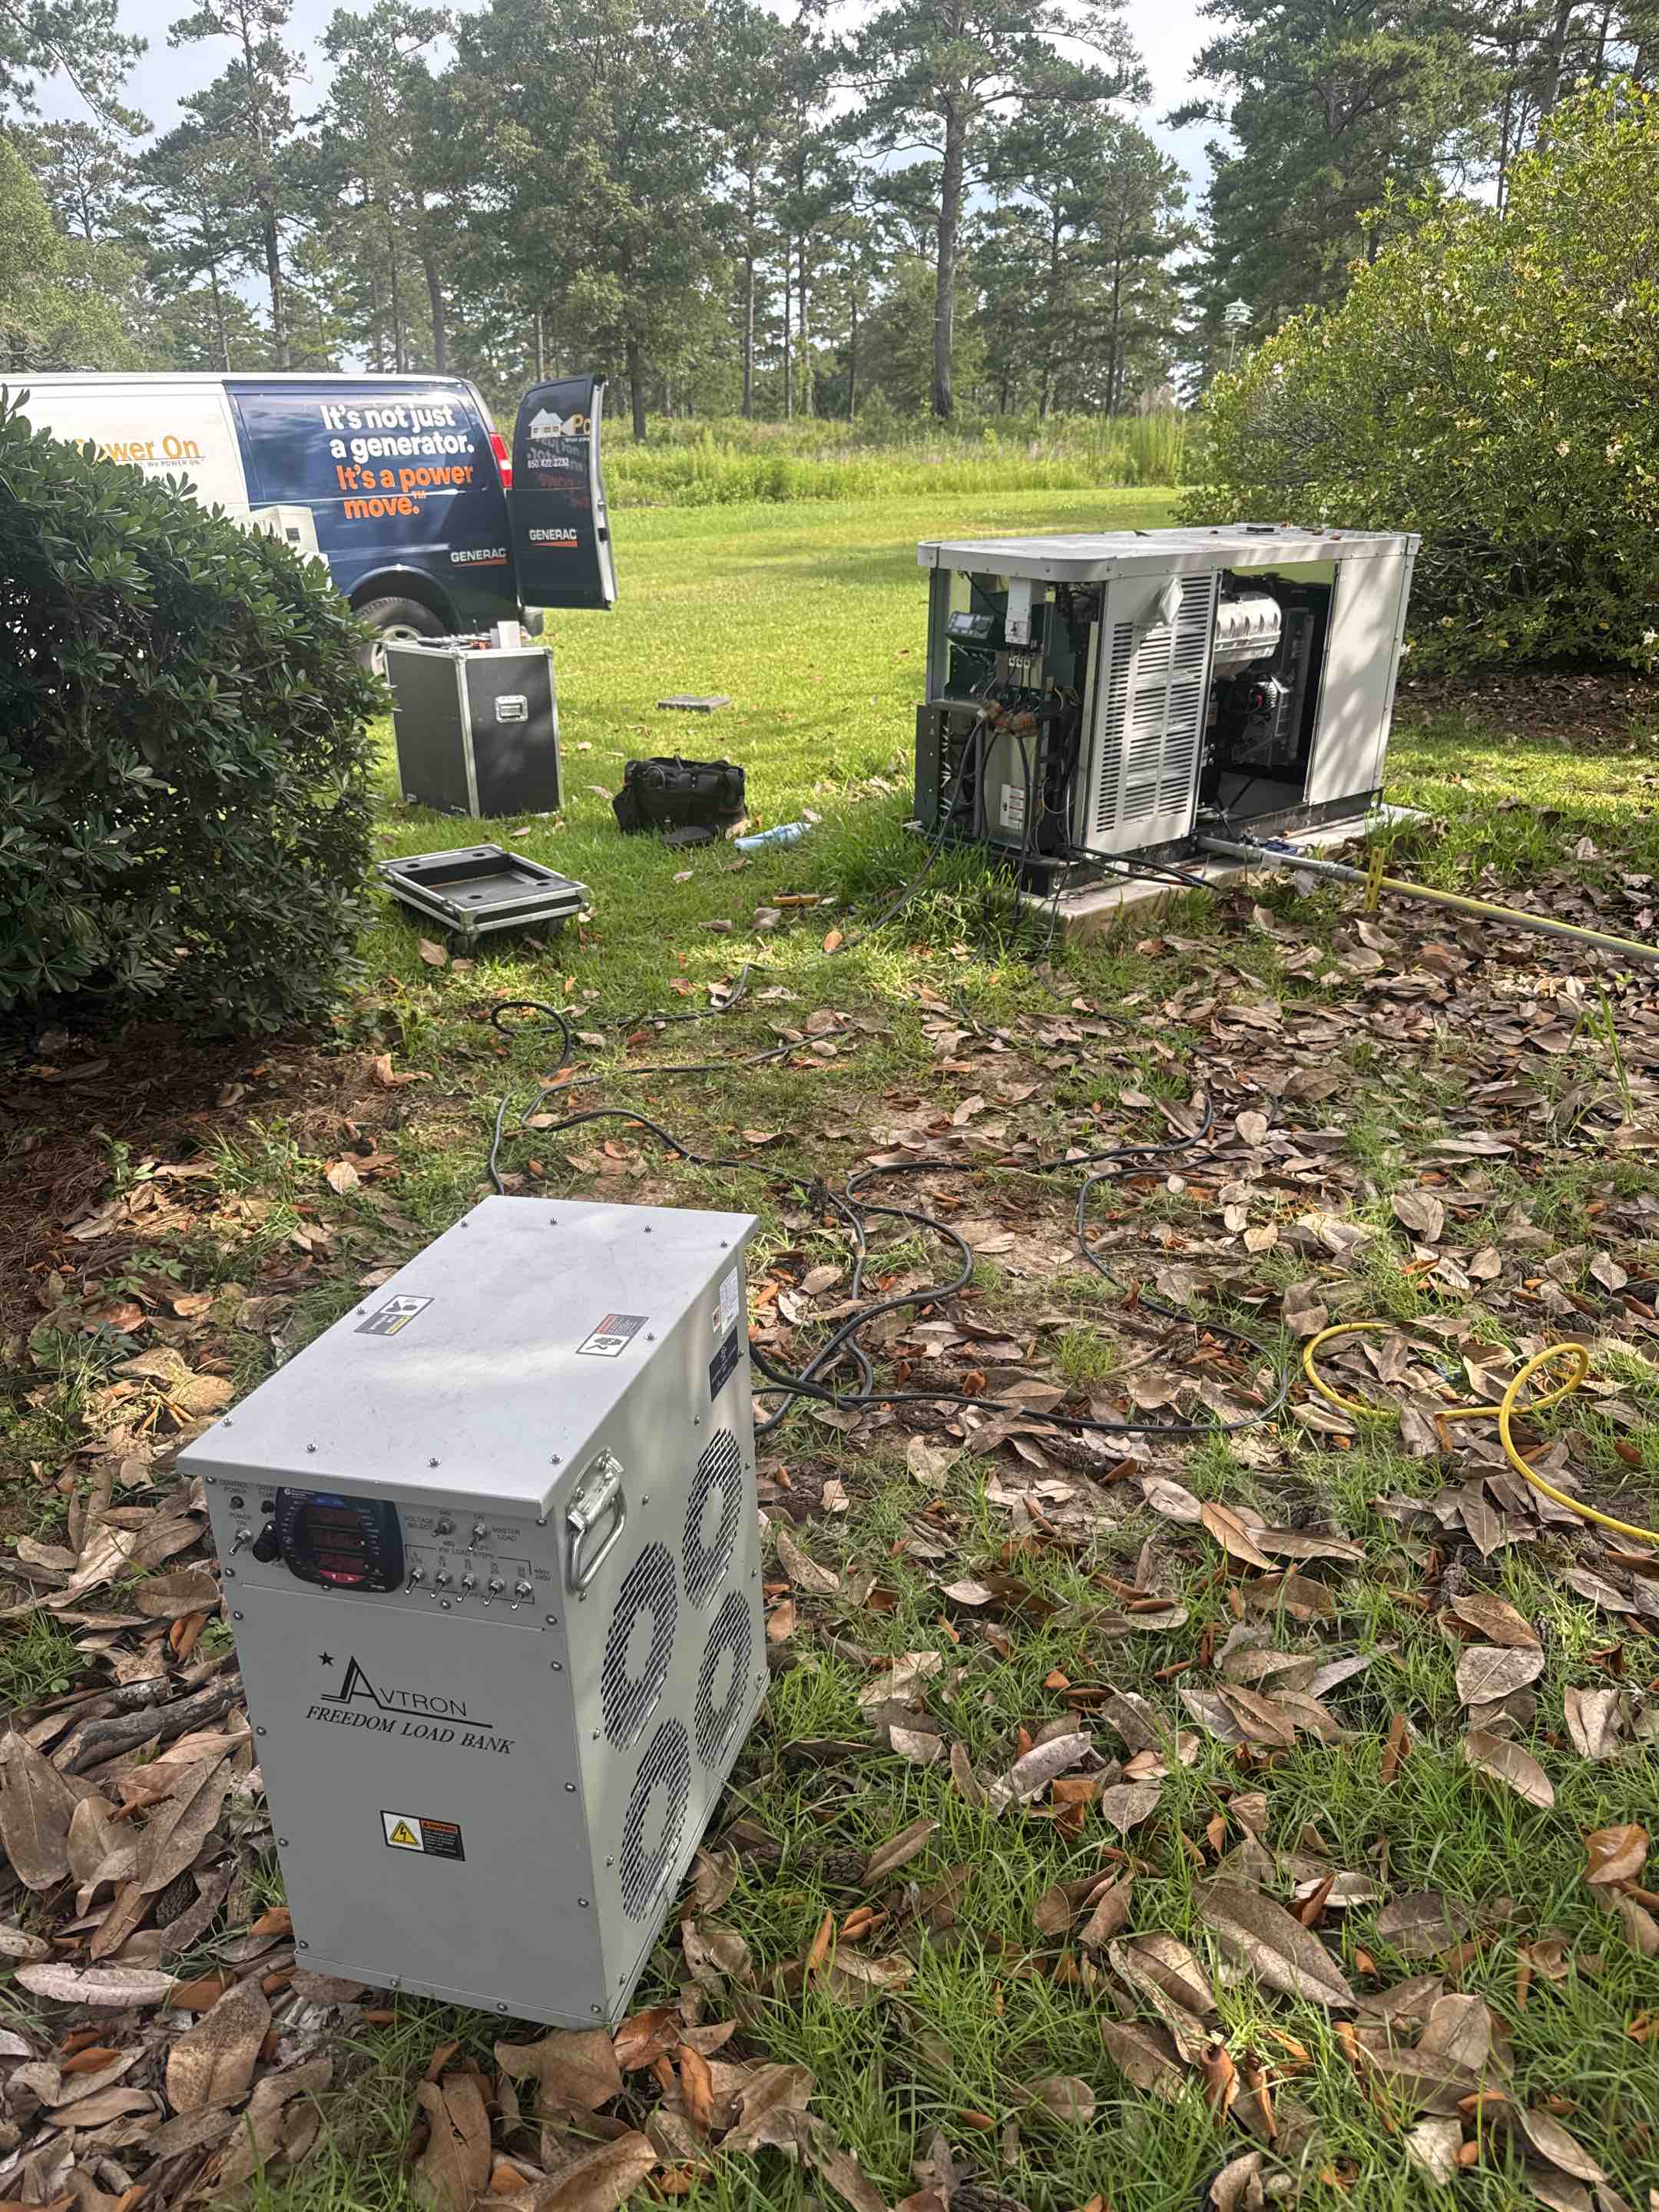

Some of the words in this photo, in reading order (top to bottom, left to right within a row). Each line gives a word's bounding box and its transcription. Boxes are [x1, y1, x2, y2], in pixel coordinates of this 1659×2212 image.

[320, 405, 363, 430] It's
[365, 405, 409, 428] not
[408, 404, 455, 433] just
[162, 434, 200, 459] On
[329, 439, 347, 459] a
[350, 432, 475, 464] generator.
[336, 464, 377, 491] It's
[379, 468, 396, 488] a
[399, 466, 474, 493] power
[528, 528, 578, 541] GENERAC
[450, 548, 507, 563] GENERAC
[306, 1704, 396, 1734] FREEDOM
[401, 1722, 455, 1743] LOAD
[461, 1733, 515, 1754] BANK
